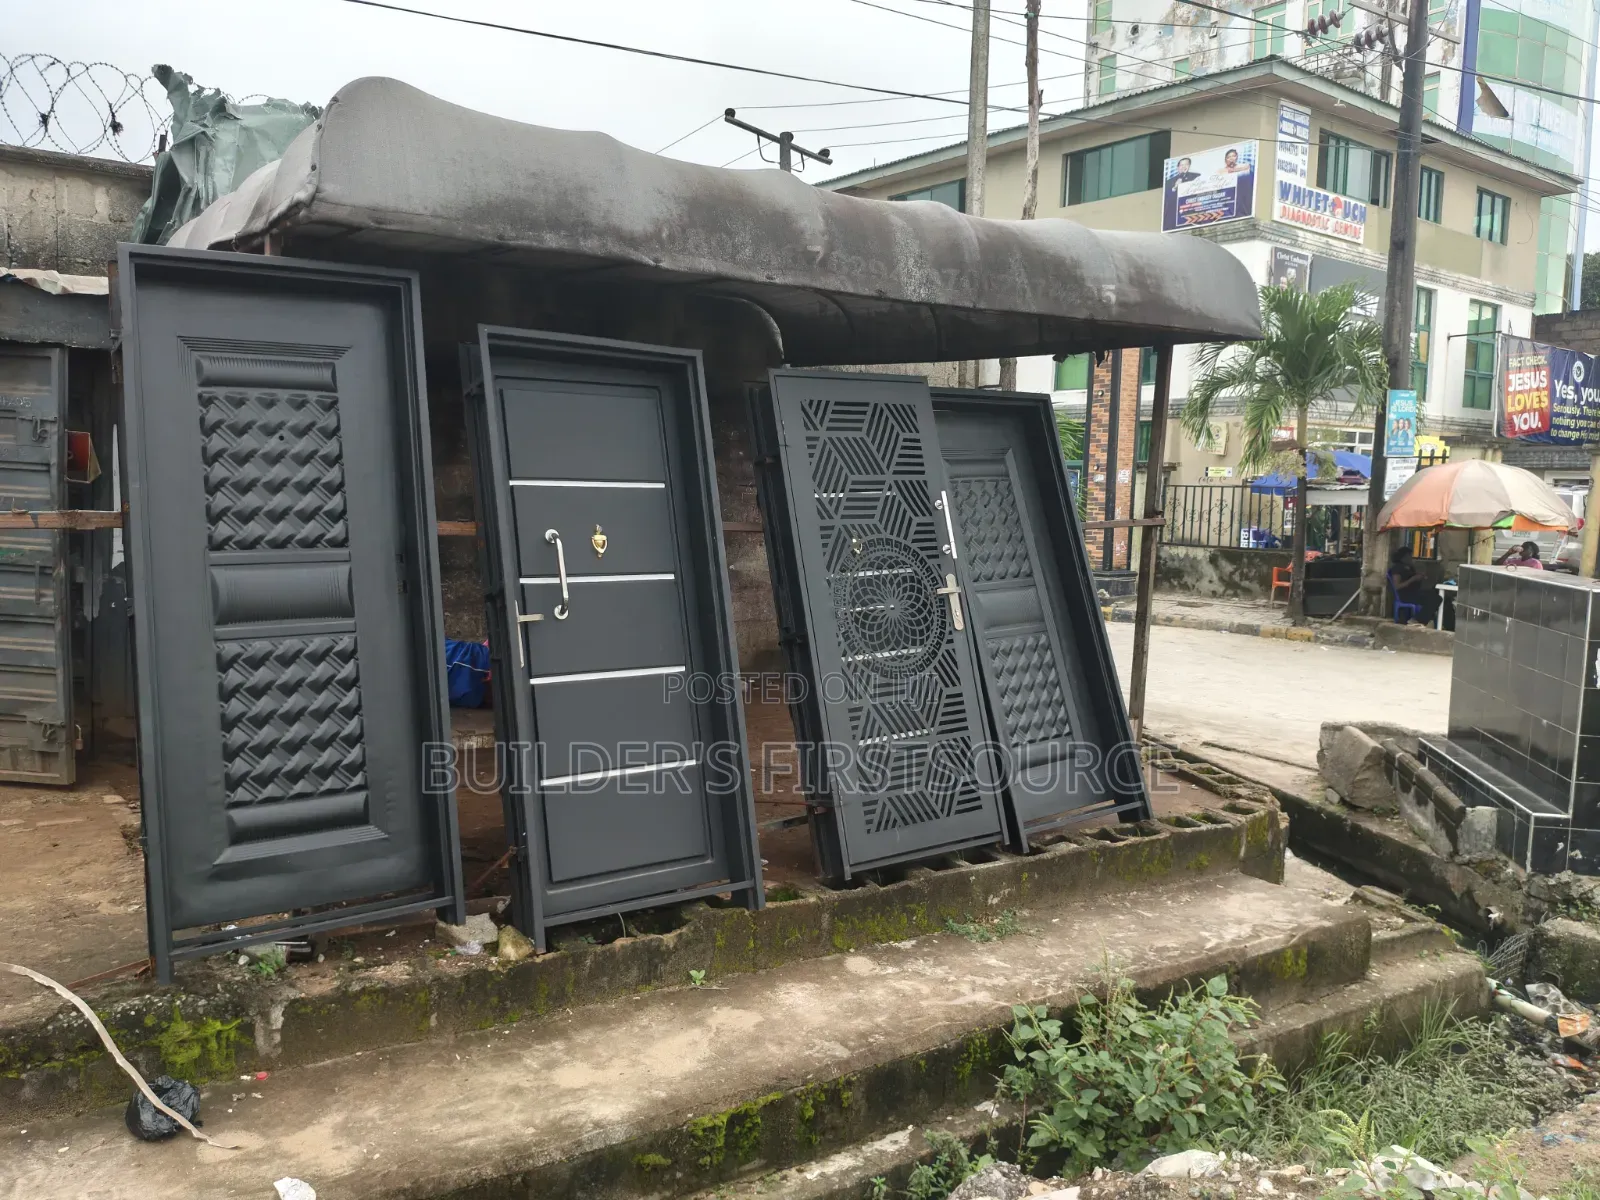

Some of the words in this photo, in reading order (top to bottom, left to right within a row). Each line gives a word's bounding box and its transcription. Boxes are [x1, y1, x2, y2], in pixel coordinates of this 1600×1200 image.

[1280, 205, 1330, 230] DIAGNOSTIC
[1333, 221, 1361, 239] CENTRE
[1509, 357, 1524, 368] FACT
[1508, 370, 1547, 392] JESUS
[1554, 379, 1577, 403] Yes,
[1508, 391, 1548, 412] LOVES
[1553, 403, 1581, 416] Seriously.
[1513, 411, 1541, 431] YOU.
[1552, 417, 1575, 428] nothing
[1551, 428, 1557, 436] to
[1558, 428, 1580, 440] change
